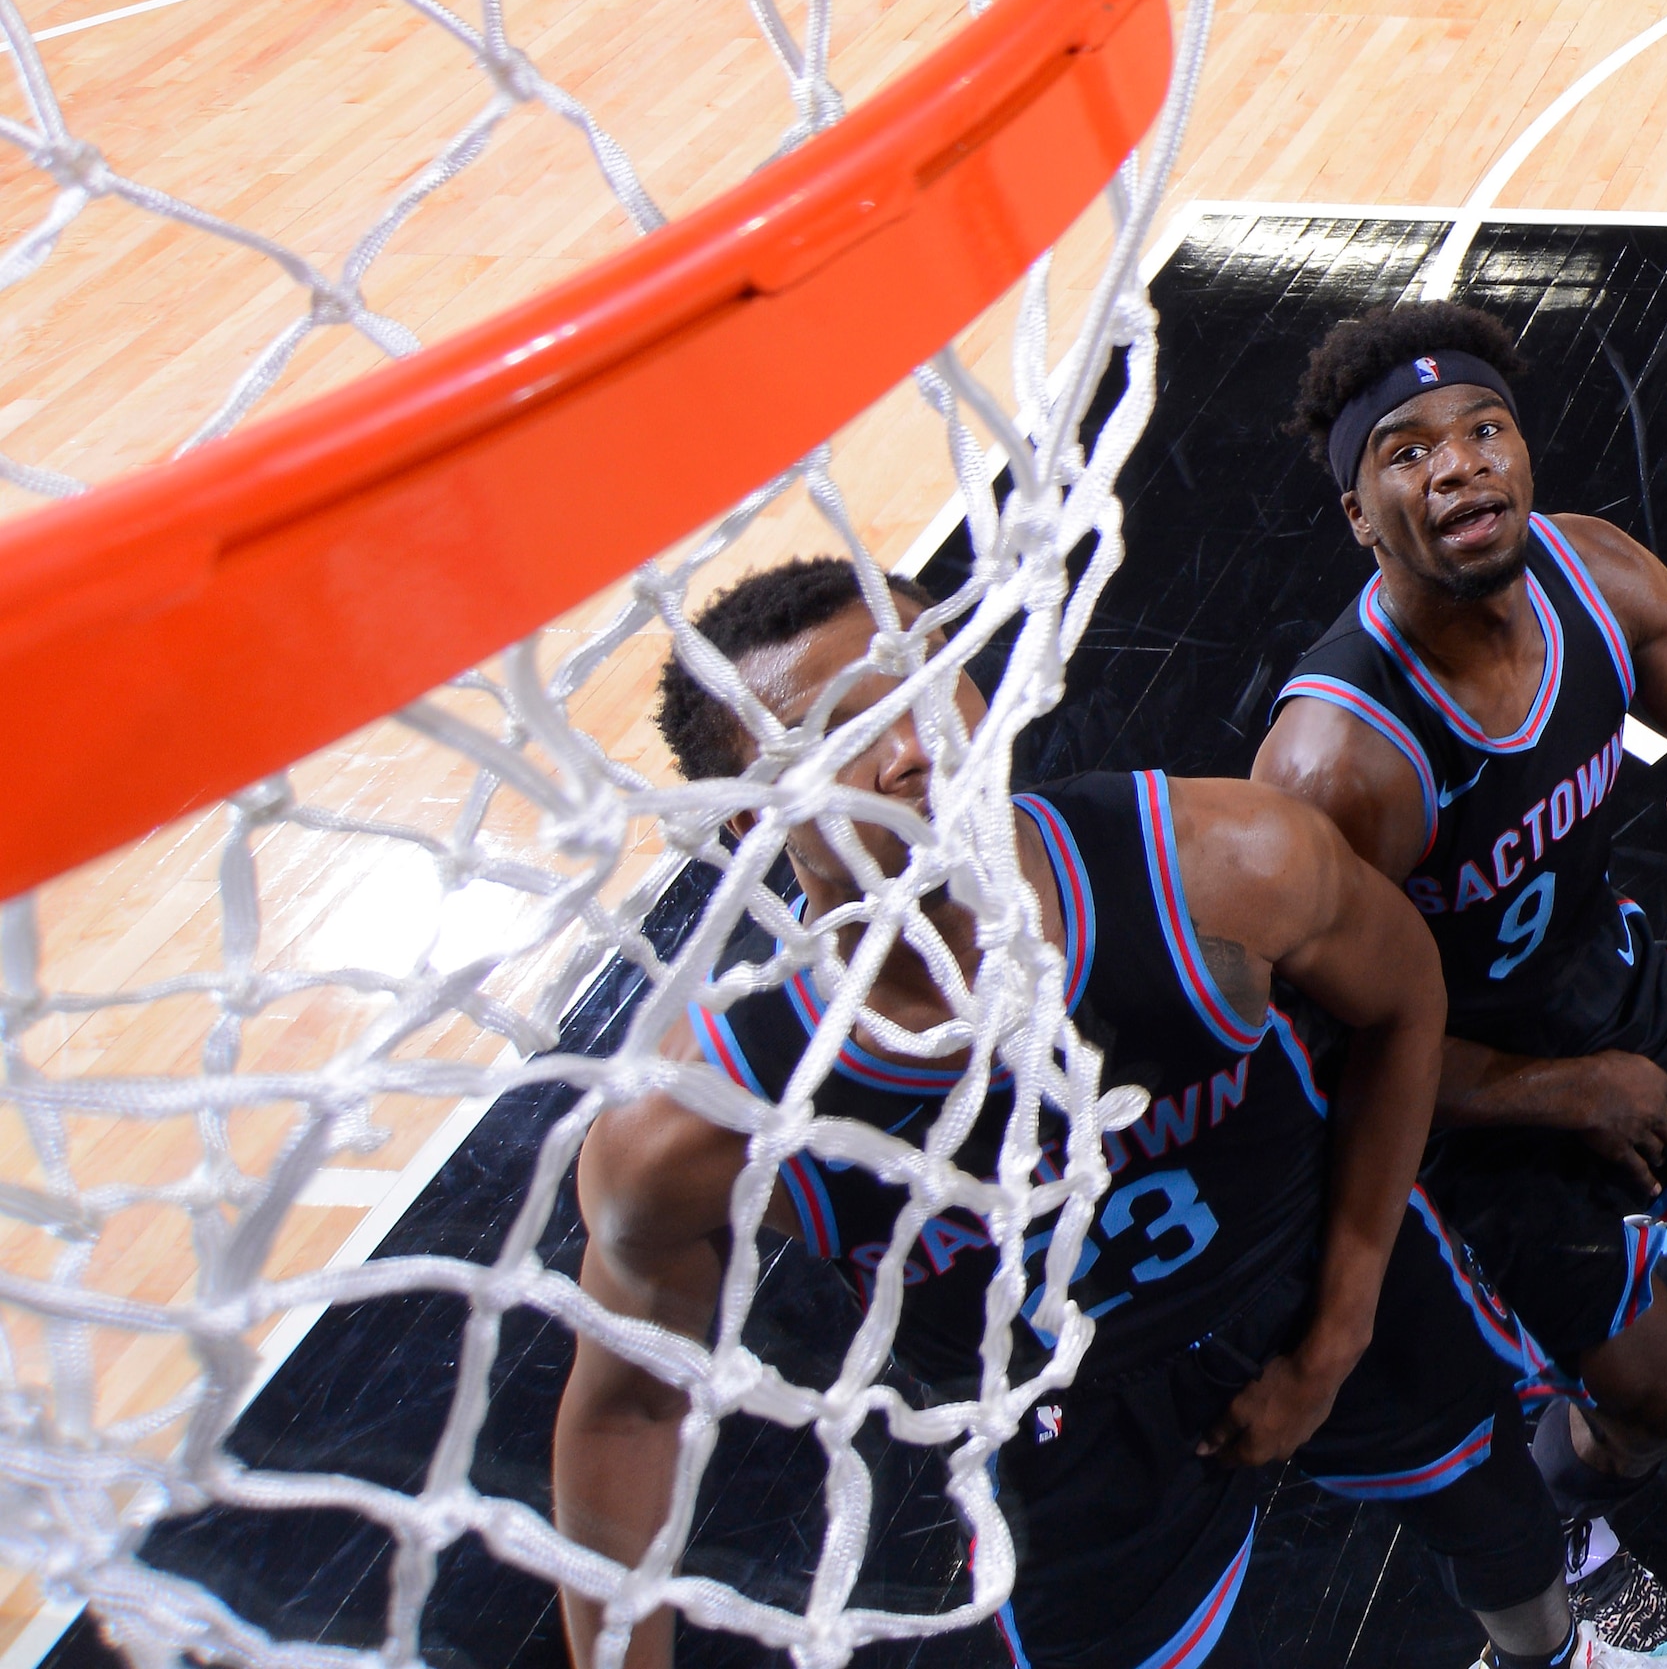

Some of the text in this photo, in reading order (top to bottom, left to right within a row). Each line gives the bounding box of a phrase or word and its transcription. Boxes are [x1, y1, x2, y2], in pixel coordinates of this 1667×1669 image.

[1403, 718, 1625, 914] SACTOWN
[1489, 871, 1557, 980] 9
[992, 1168, 1220, 1351] 23
